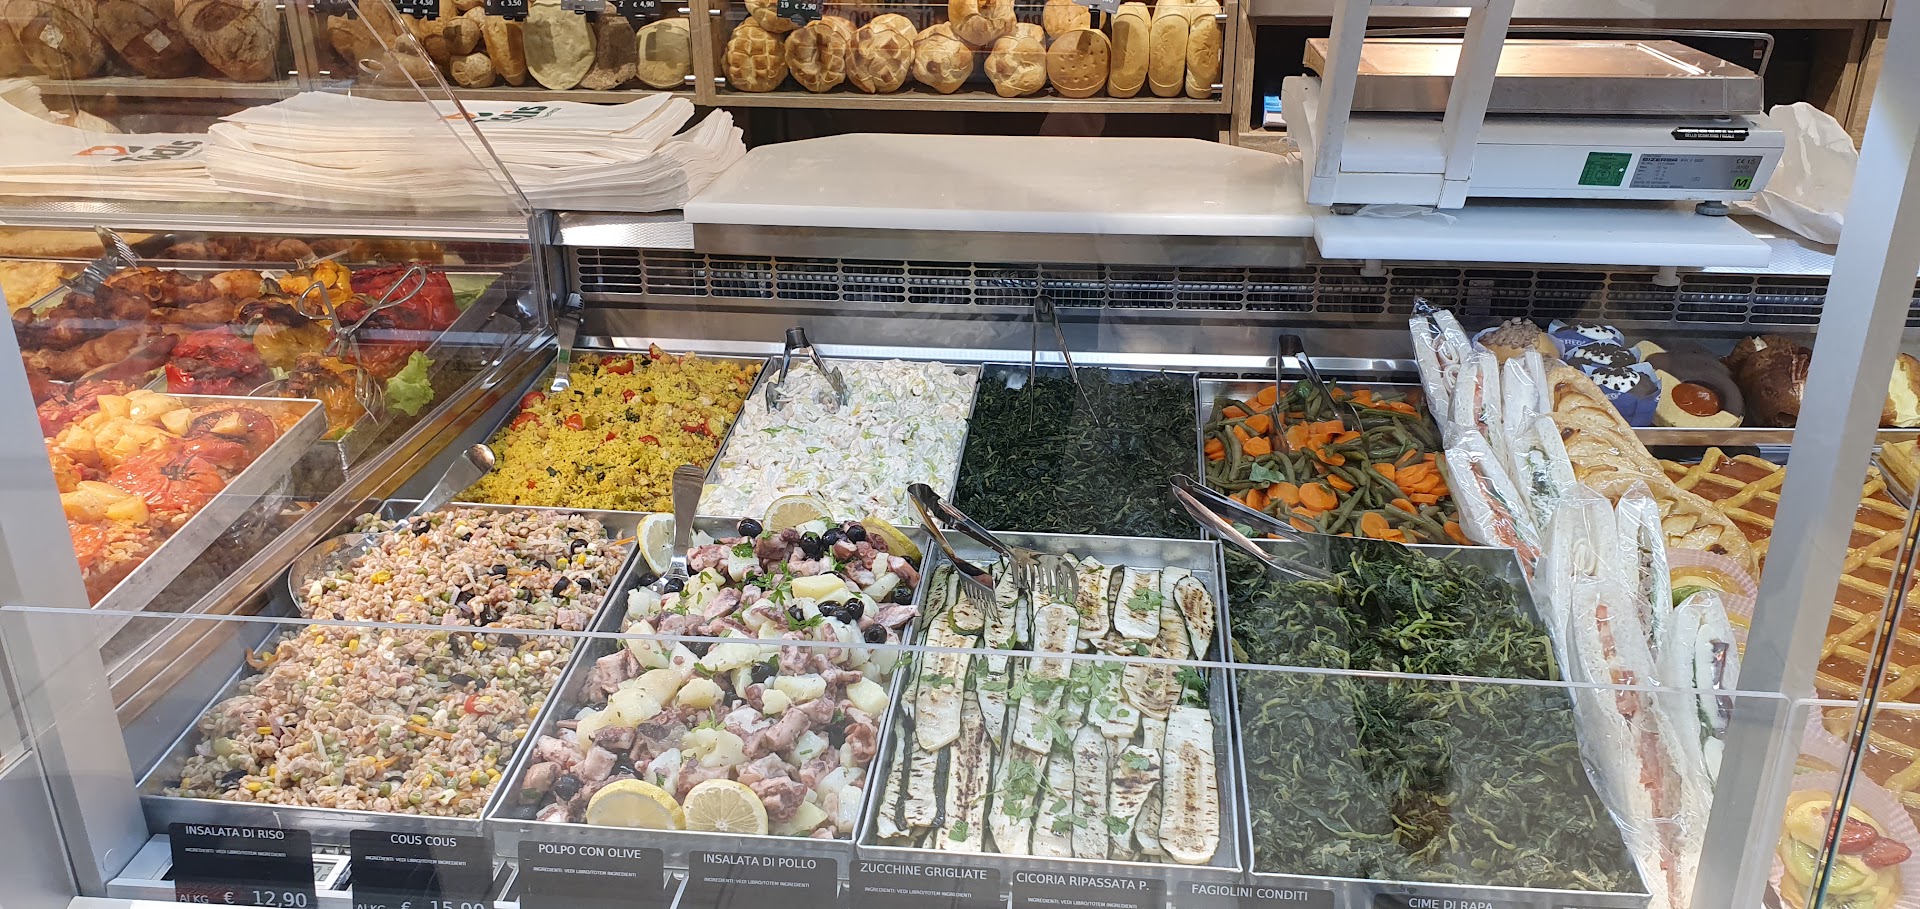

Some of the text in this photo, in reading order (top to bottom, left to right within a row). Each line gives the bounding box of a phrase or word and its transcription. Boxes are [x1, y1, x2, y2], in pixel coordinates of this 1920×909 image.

[1734, 179, 1748, 187] M
[185, 825, 285, 840] INSALATA DI RISO
[390, 834, 457, 847] COUS COUS
[538, 843, 642, 859] POLPO CON OLIVE
[703, 853, 817, 870] INSALATA DI POLLO
[860, 862, 987, 880] ZUCCHINE GRIGLIATE
[1016, 872, 1150, 891] CICORIA RIPASSATA P.
[193, 895, 209, 904] KG
[223, 891, 235, 904] €
[252, 890, 307, 908] 12,90
[1191, 883, 1308, 902] FAGIOLINI CONDITI
[1408, 897, 1493, 909] CIME DI RAPA
